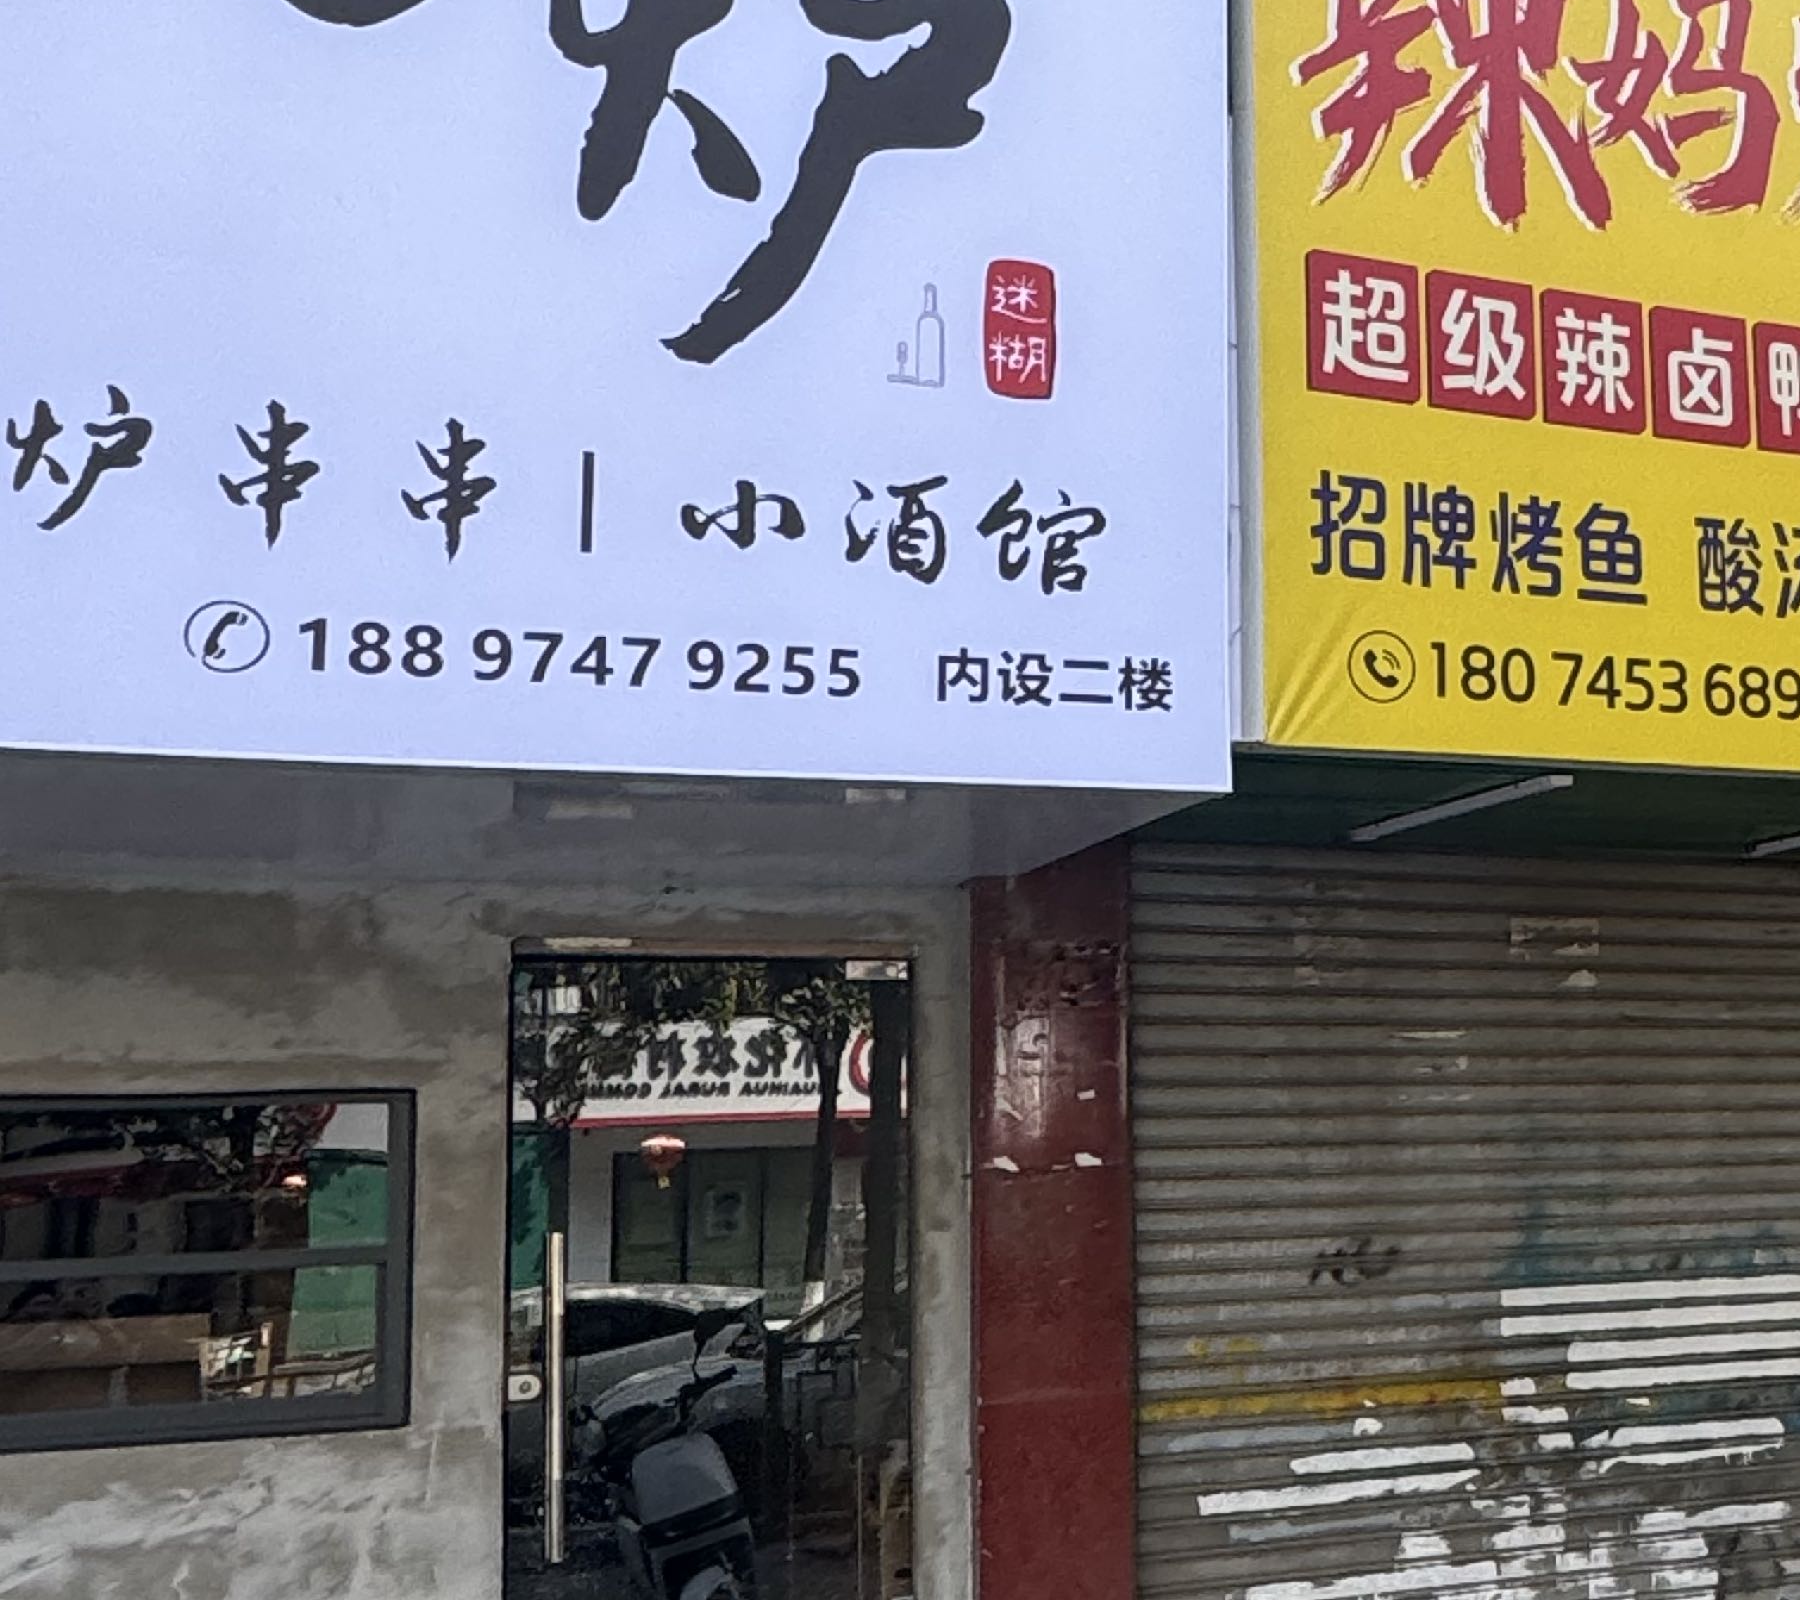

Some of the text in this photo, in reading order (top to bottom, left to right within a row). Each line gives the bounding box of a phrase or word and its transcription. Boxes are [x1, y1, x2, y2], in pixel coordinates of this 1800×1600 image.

[988, 274, 1047, 383] 迷糊
[1310, 469, 1649, 607] 招牌烤鱼
[299, 617, 1174, 712] 188 9747 9255 内设二楼
[1430, 640, 1536, 704] 180
[1550, 650, 1690, 715] 7453
